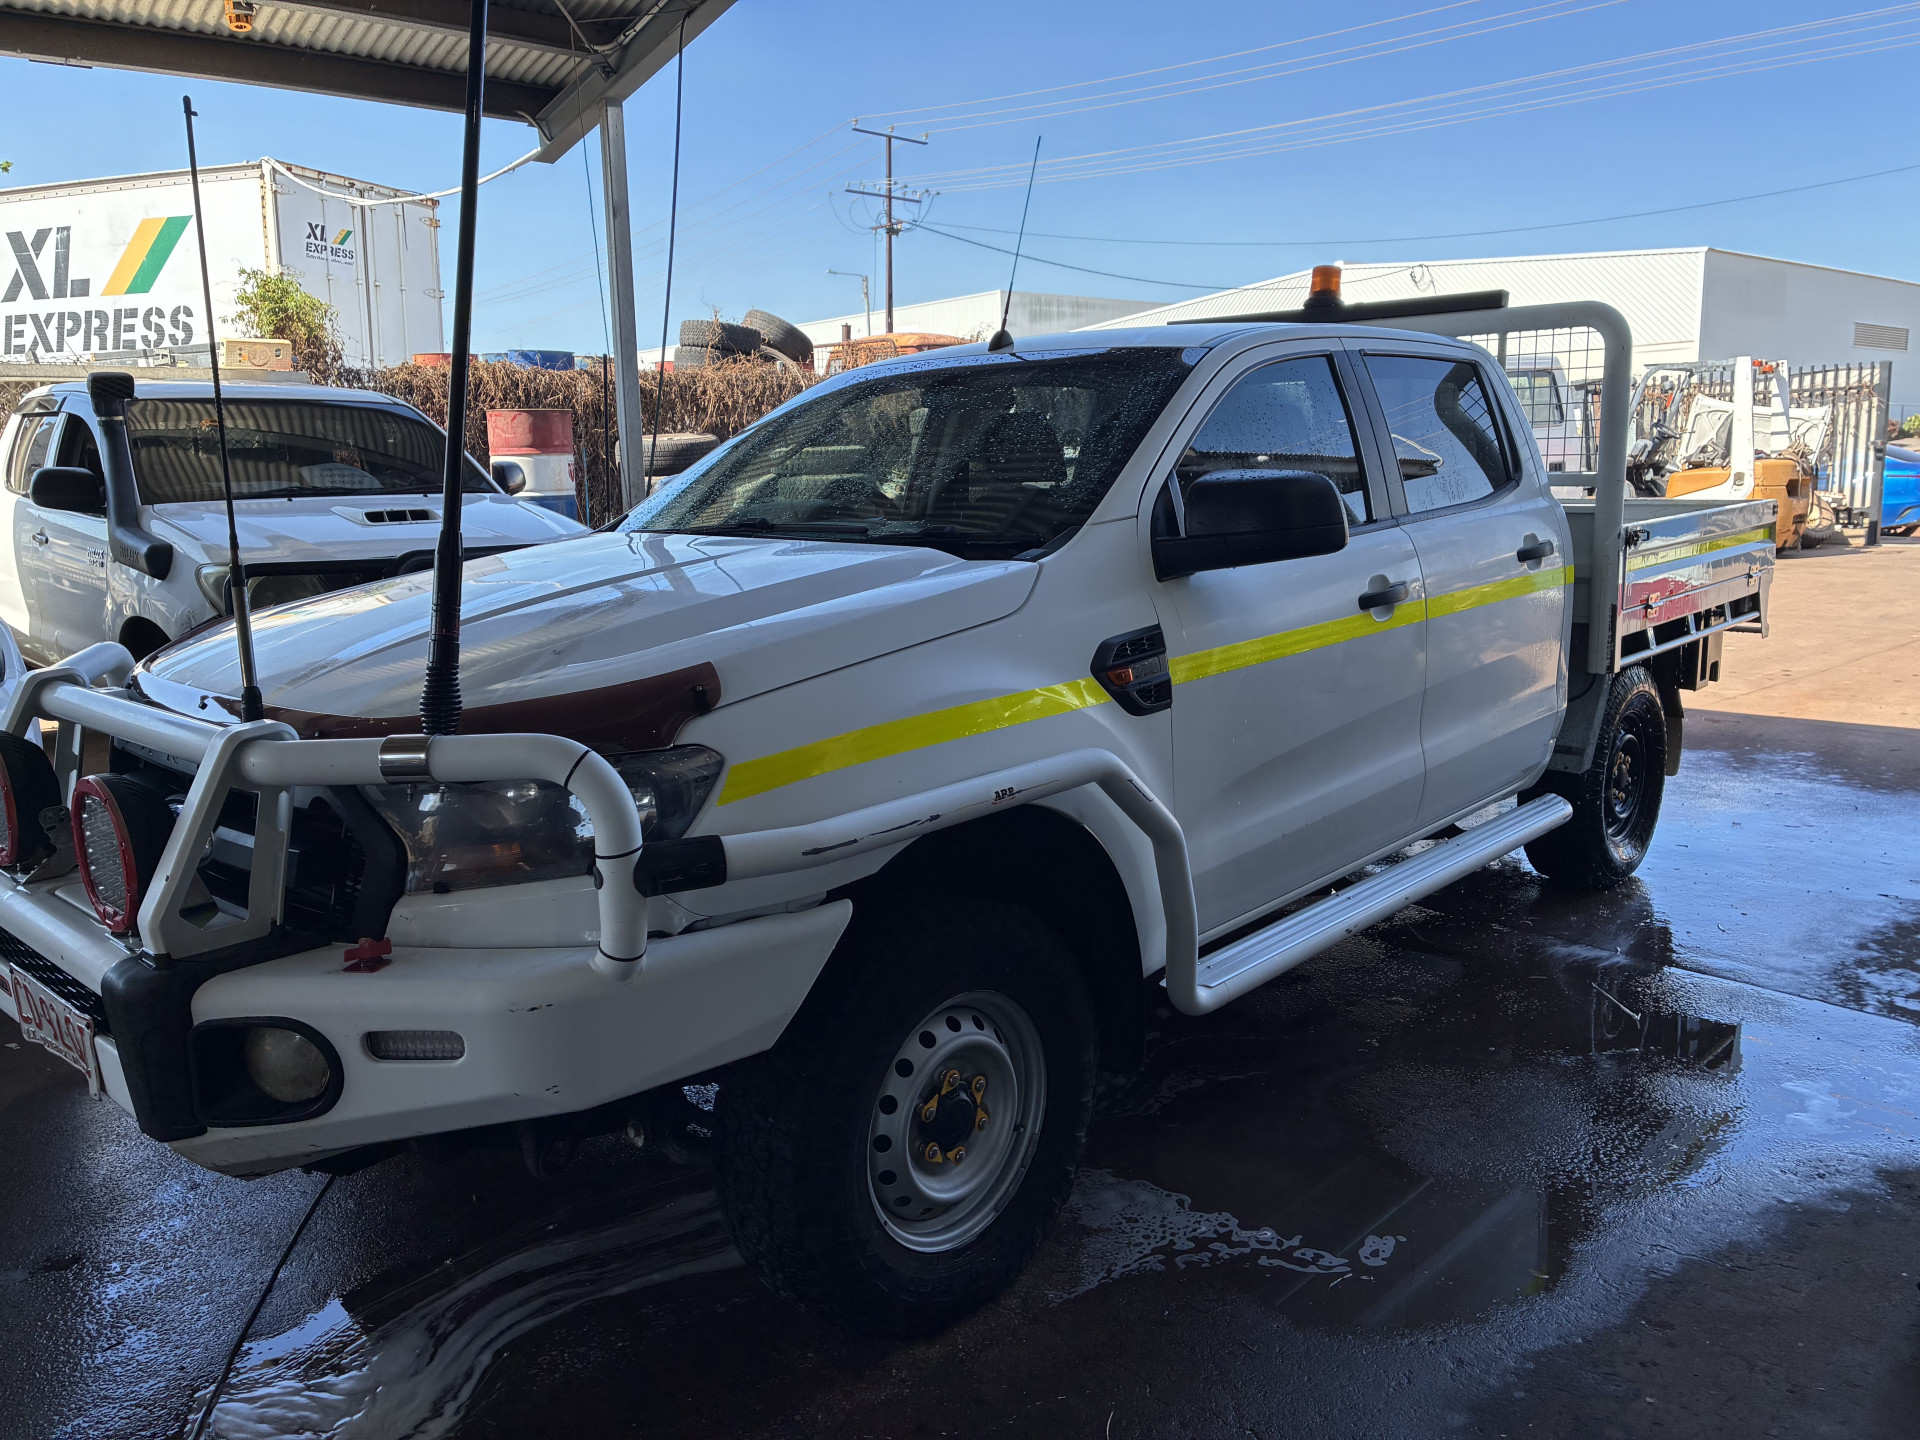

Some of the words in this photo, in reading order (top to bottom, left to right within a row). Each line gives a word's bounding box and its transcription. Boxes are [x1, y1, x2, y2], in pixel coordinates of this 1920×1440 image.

[0, 226, 91, 303] XL
[305, 242, 354, 260] EXPRESS
[4, 305, 194, 355] EXPRESS
